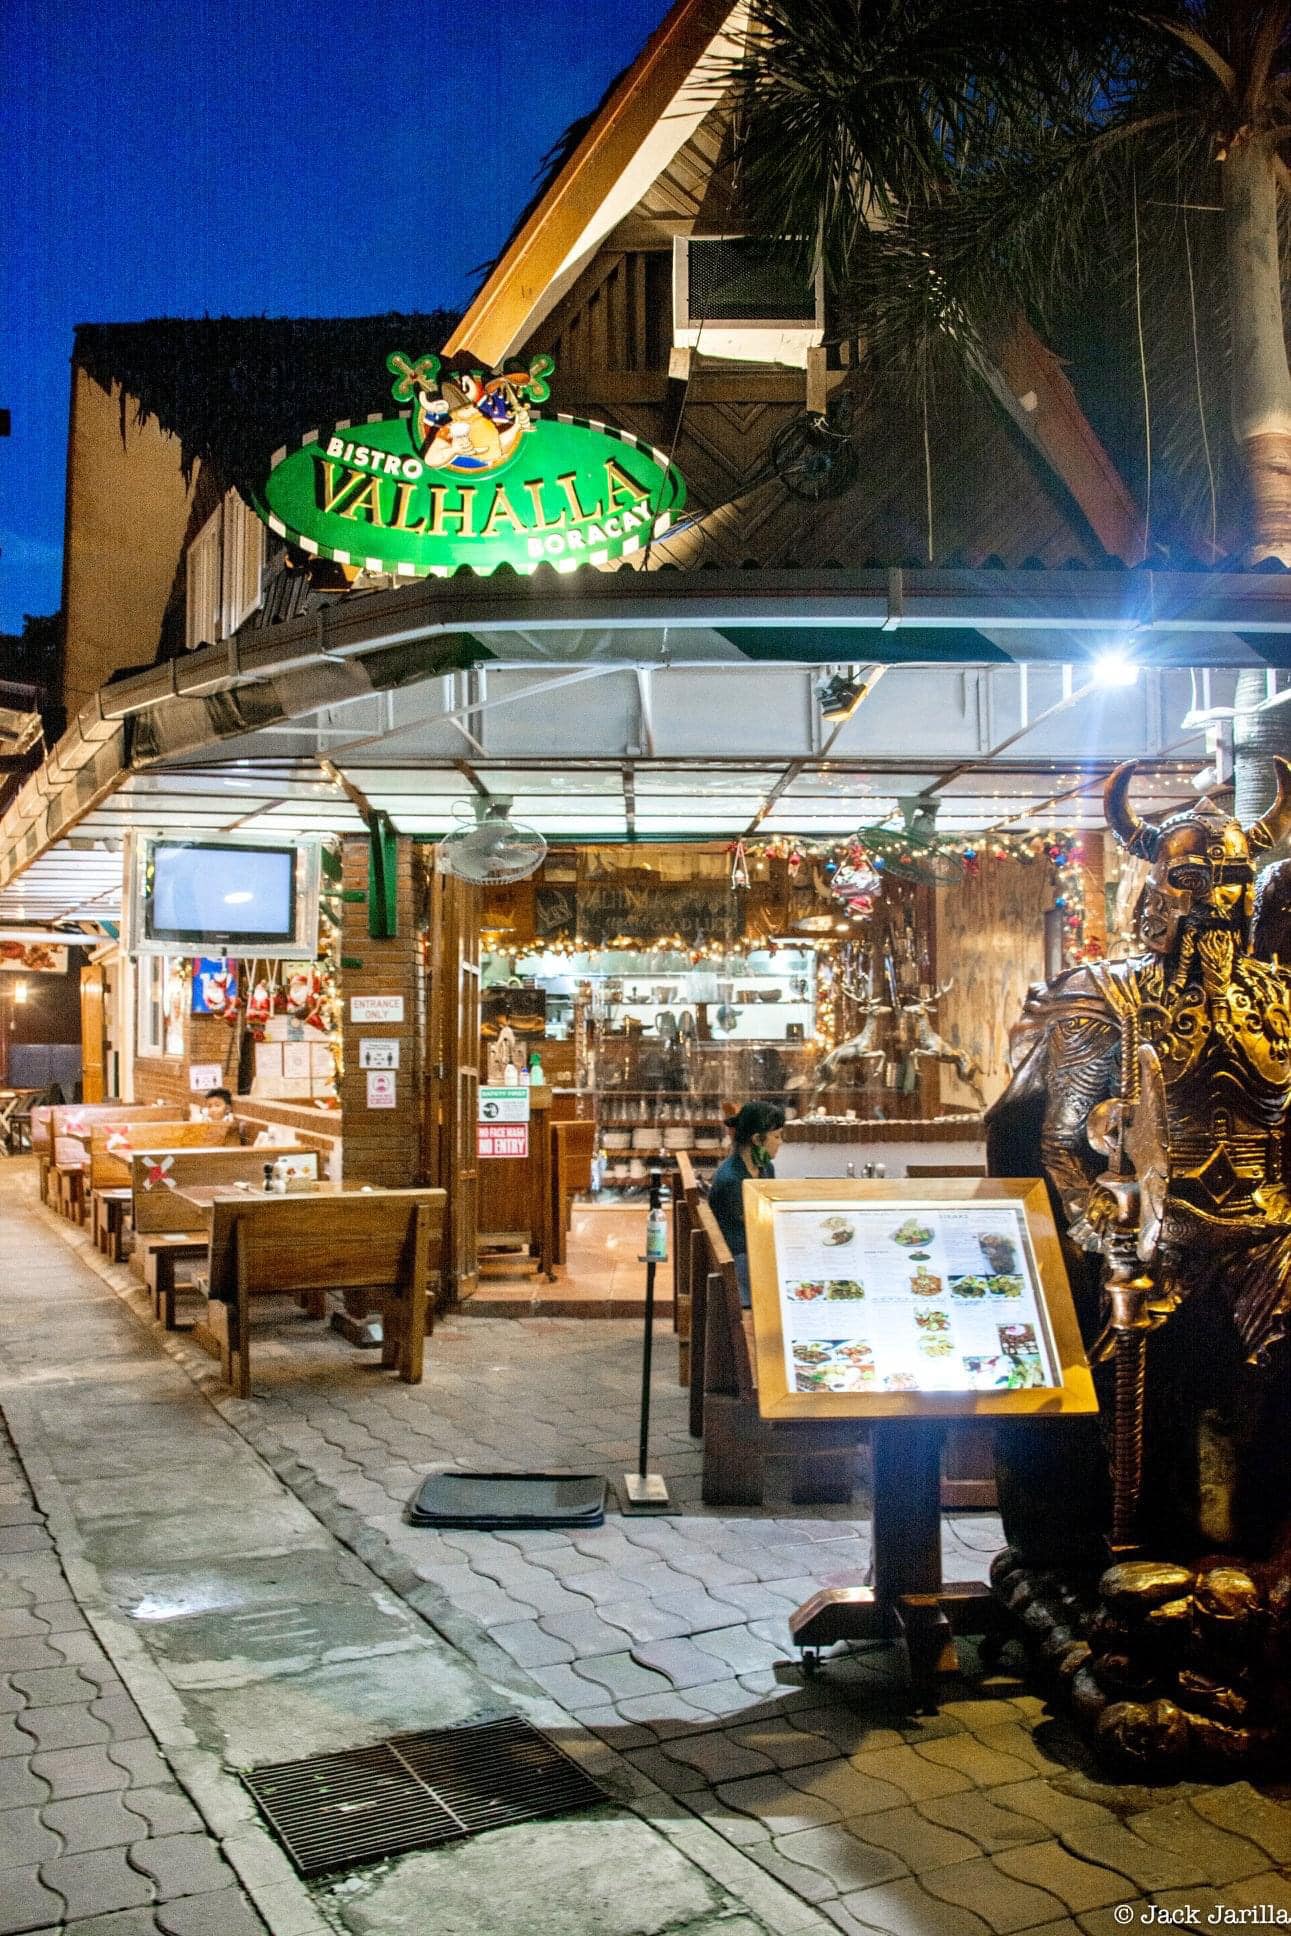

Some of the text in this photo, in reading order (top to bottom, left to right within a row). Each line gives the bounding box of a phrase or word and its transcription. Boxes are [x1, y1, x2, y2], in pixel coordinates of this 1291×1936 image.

[325, 436, 424, 481] BISTRO
[313, 456, 651, 537] VALHALLA
[526, 500, 655, 558] BORACAY
[353, 999, 401, 1009] ENTRANCE
[365, 1010, 389, 1020] ONLY
[495, 1138, 527, 1155] ENTRY
